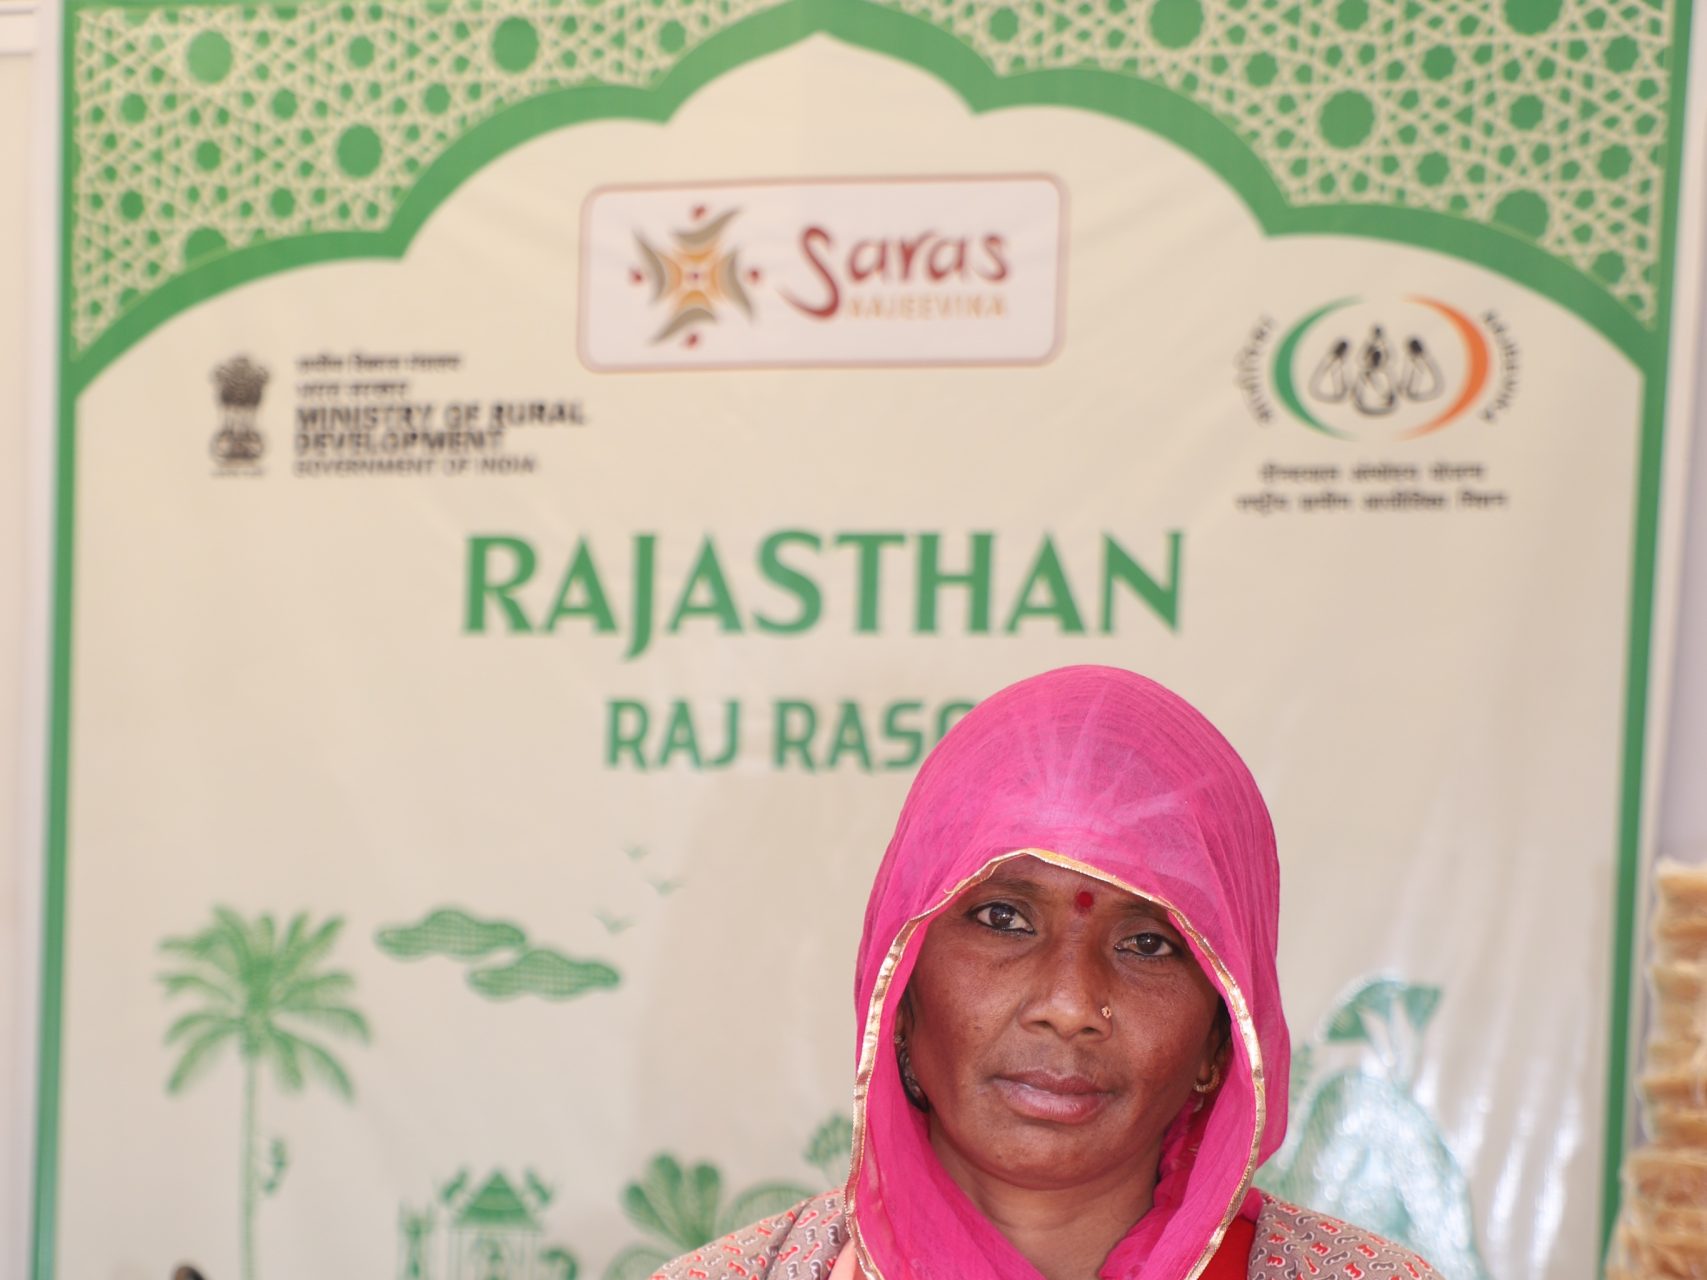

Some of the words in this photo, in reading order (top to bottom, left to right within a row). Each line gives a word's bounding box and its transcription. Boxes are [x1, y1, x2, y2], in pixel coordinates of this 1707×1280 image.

[777, 226, 1011, 322] Saras
[296, 404, 433, 430] MINISTRY
[444, 403, 480, 428] OF
[489, 400, 586, 427] RURAL
[294, 430, 504, 455] DEVELOPMENT
[294, 459, 435, 477] GOVERNMENT
[475, 456, 537, 475] INDIA
[462, 530, 1184, 661] RAJASTHAN
[605, 698, 740, 769] RAJ
